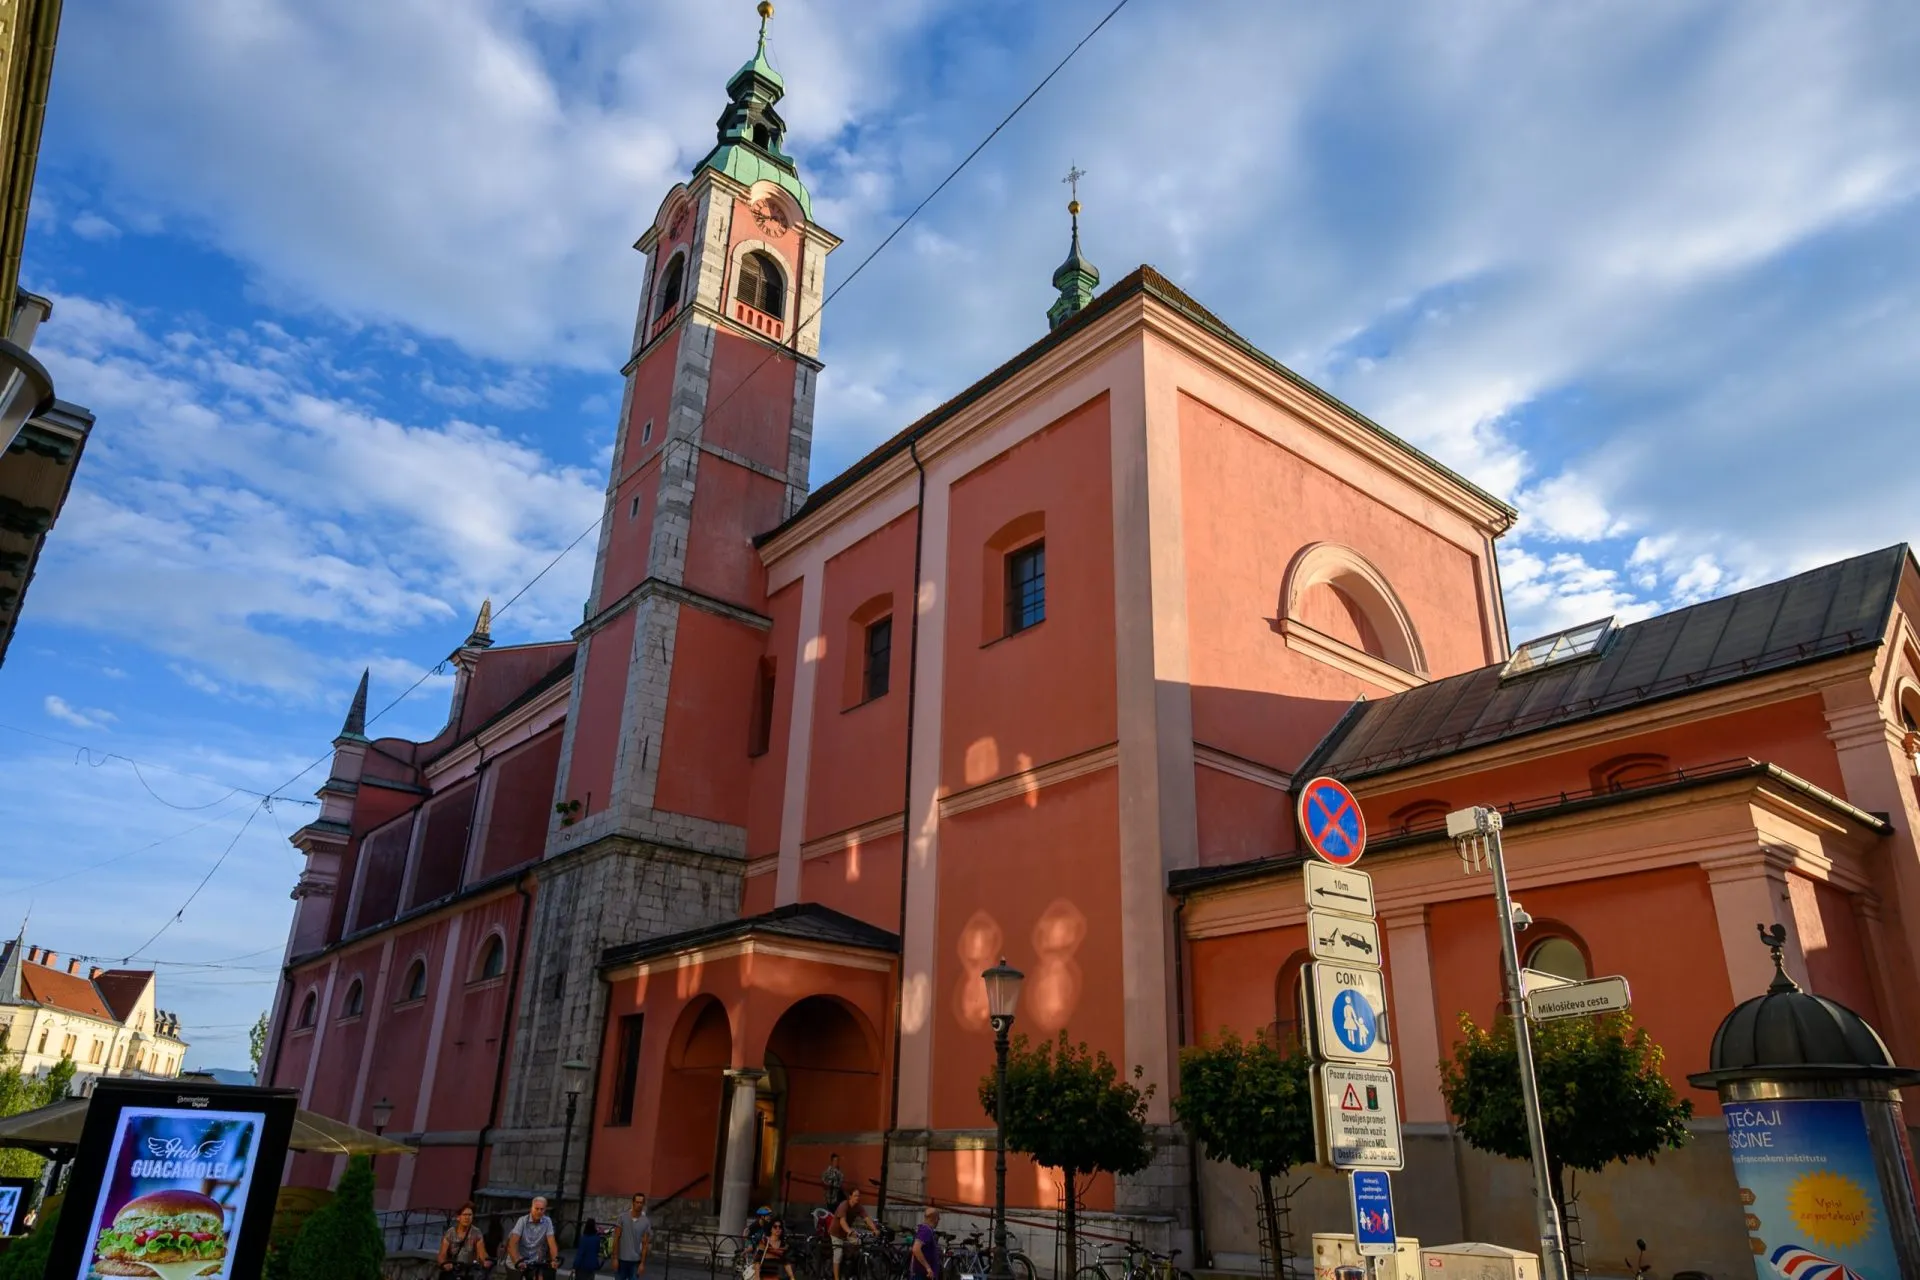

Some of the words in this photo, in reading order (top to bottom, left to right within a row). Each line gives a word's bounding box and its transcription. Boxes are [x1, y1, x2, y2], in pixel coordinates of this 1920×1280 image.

[1334, 879, 1349, 891] 10m
[1336, 971, 1365, 987] CONA
[1587, 996, 1609, 1007] cesta
[1366, 1115, 1387, 1125] promet
[1729, 1107, 1781, 1127] TEČAJI
[165, 1137, 199, 1161] Holy
[131, 1159, 228, 1179] GUACAMOLE!
